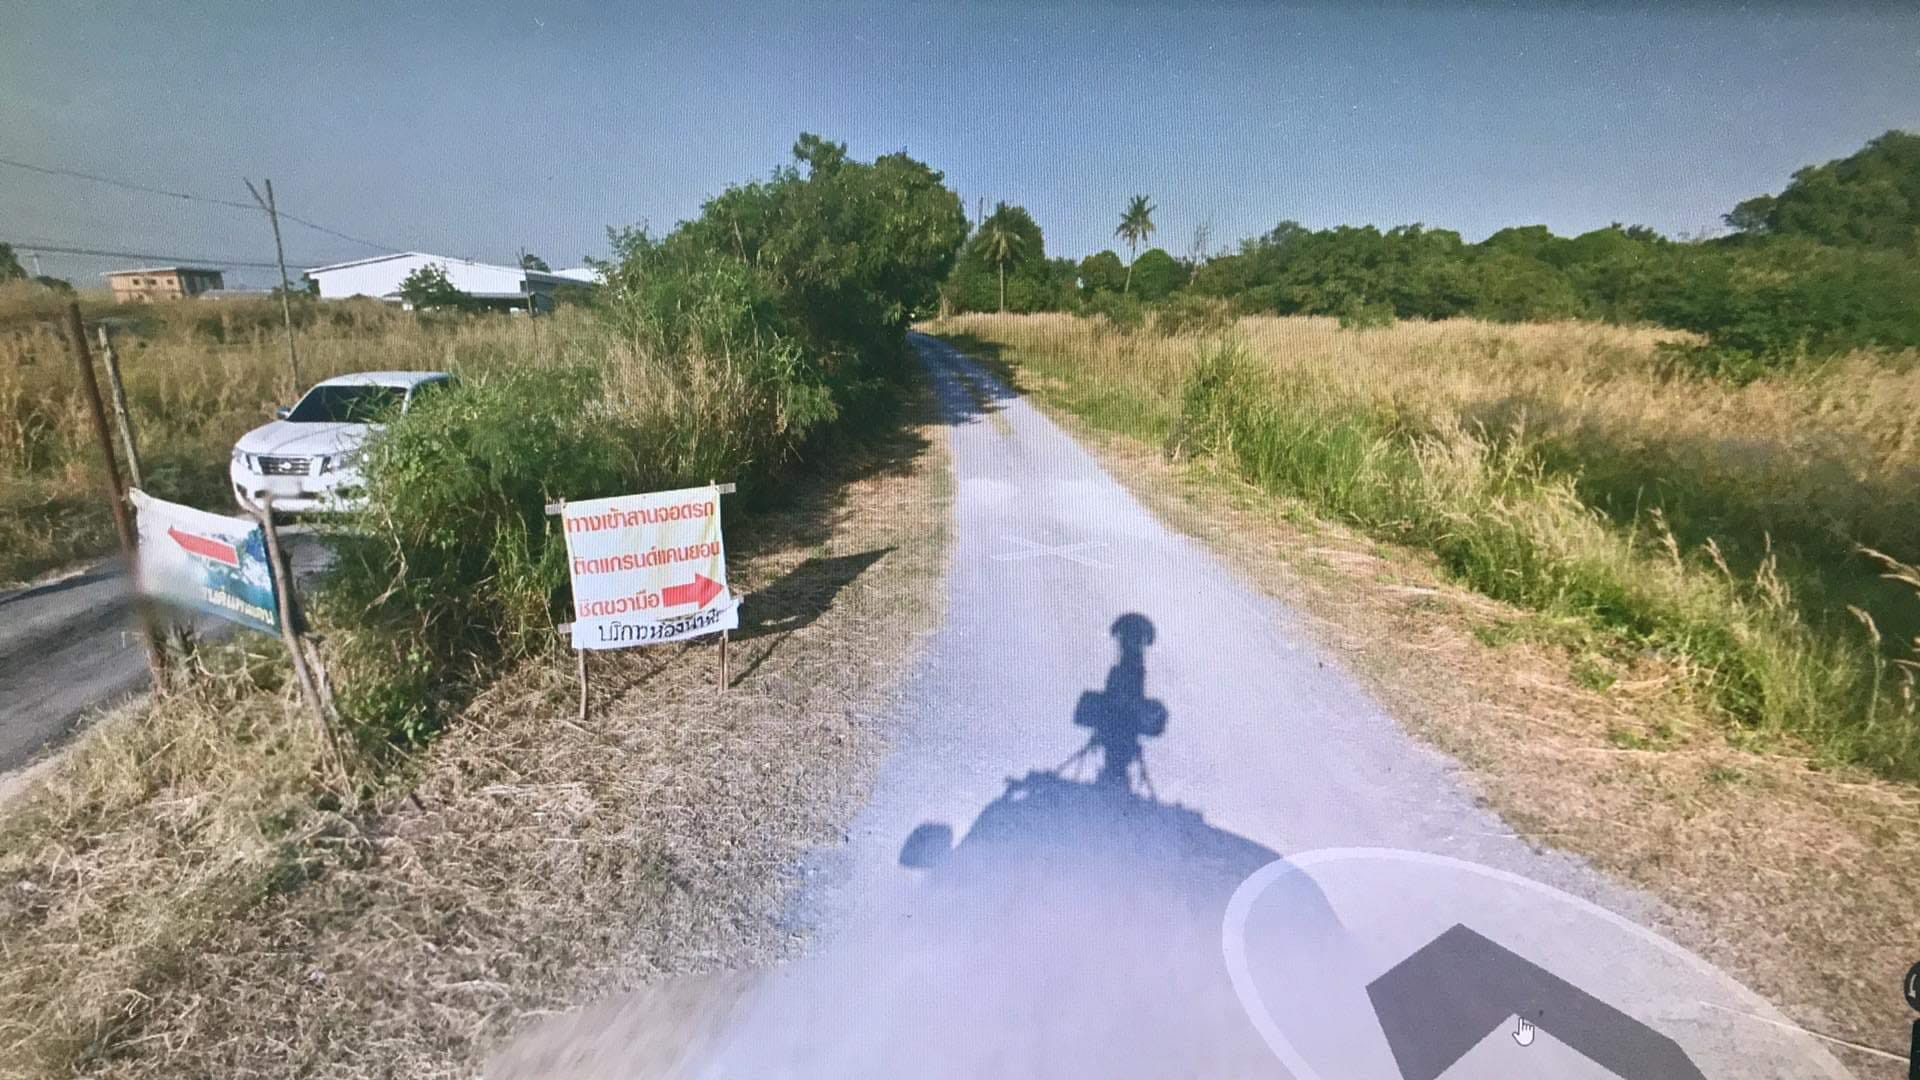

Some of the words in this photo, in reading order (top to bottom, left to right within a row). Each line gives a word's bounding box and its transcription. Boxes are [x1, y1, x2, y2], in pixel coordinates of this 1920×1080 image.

[567, 501, 714, 533] ทางเข้าลานจอดรถ
[574, 541, 720, 575] ติดแกรนด์แคนยอน
